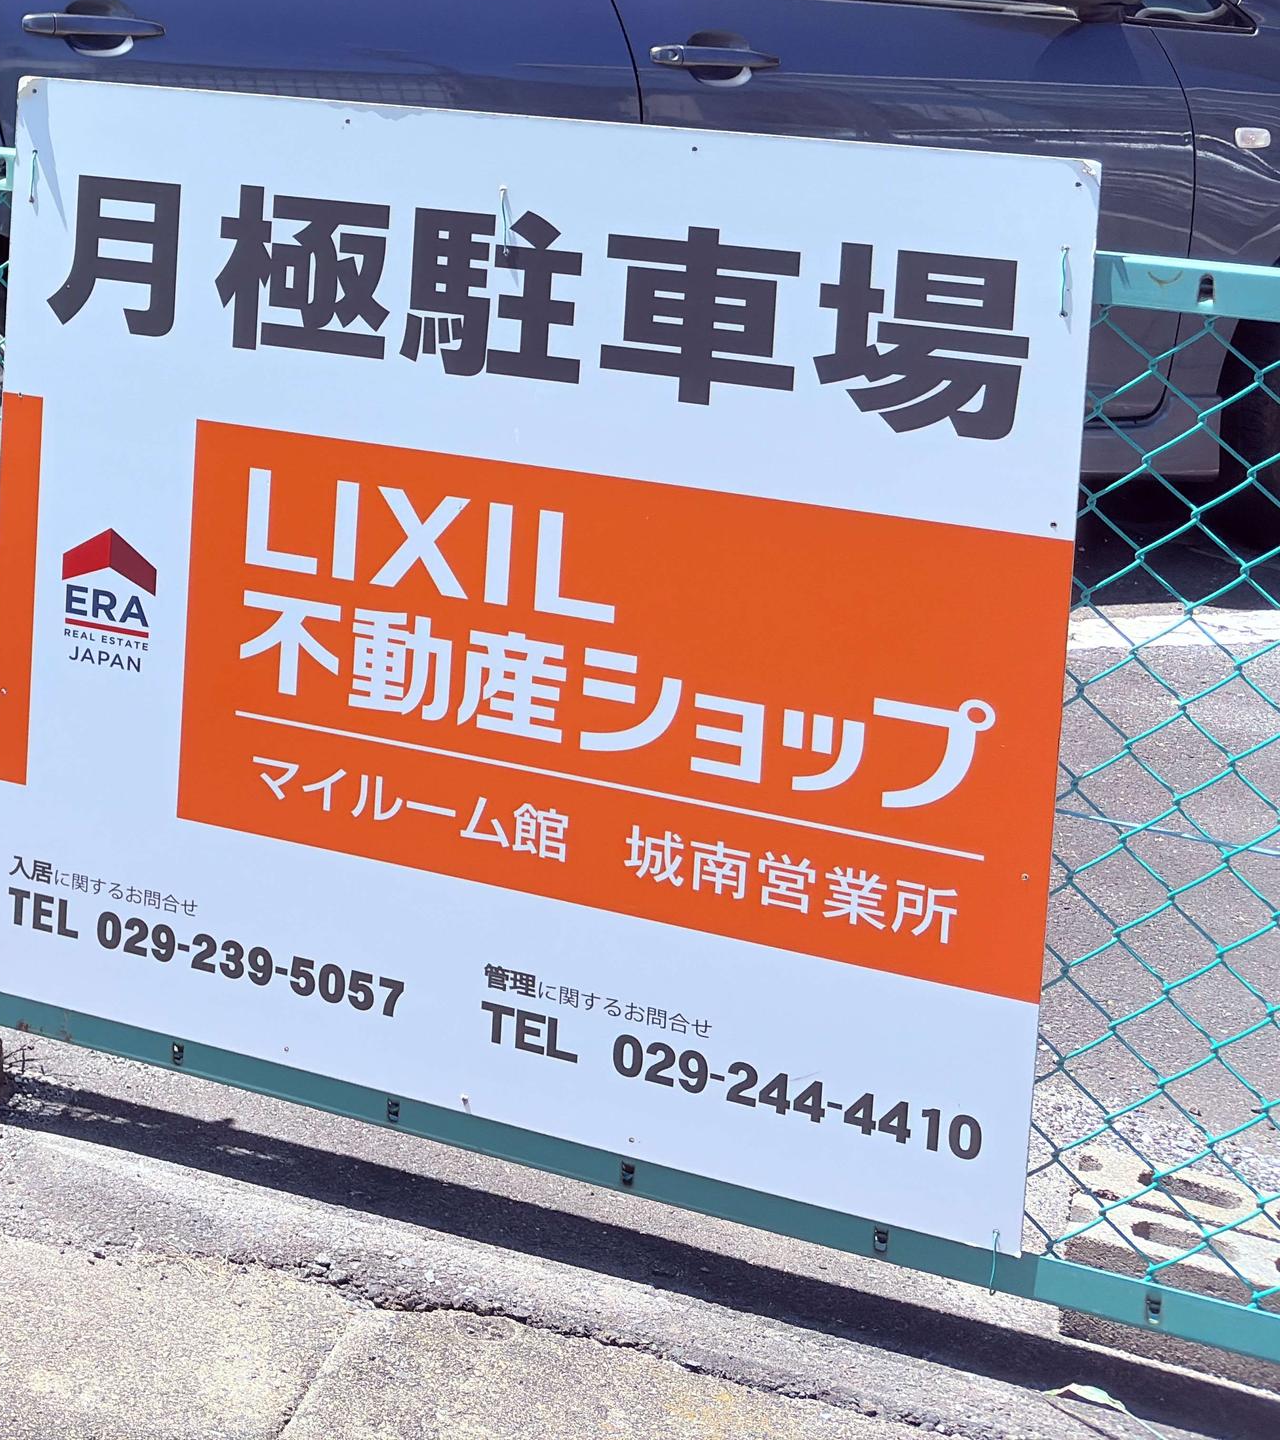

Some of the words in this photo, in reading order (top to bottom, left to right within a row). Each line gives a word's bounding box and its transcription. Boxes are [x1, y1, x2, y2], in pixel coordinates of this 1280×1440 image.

[46, 173, 1030, 440] 月極駐車場
[65, 583, 149, 628] ERA
[244, 466, 616, 624] LIXIL
[64, 628, 96, 642] REAL
[101, 635, 149, 652] ESTATE
[68, 646, 141, 673] JAPAN
[239, 588, 997, 809] 不動産ショップ
[8, 854, 198, 917] 入居に関するお問合せ
[251, 755, 569, 863] マイルーム館
[623, 823, 960, 945] 城南営業所
[7, 886, 79, 940] TEL
[96, 910, 405, 1018] 029-239-5057
[483, 963, 713, 1040] 管理に関するお問合せ
[480, 1000, 579, 1064] TEL
[612, 1033, 983, 1161] 029-244-4410
